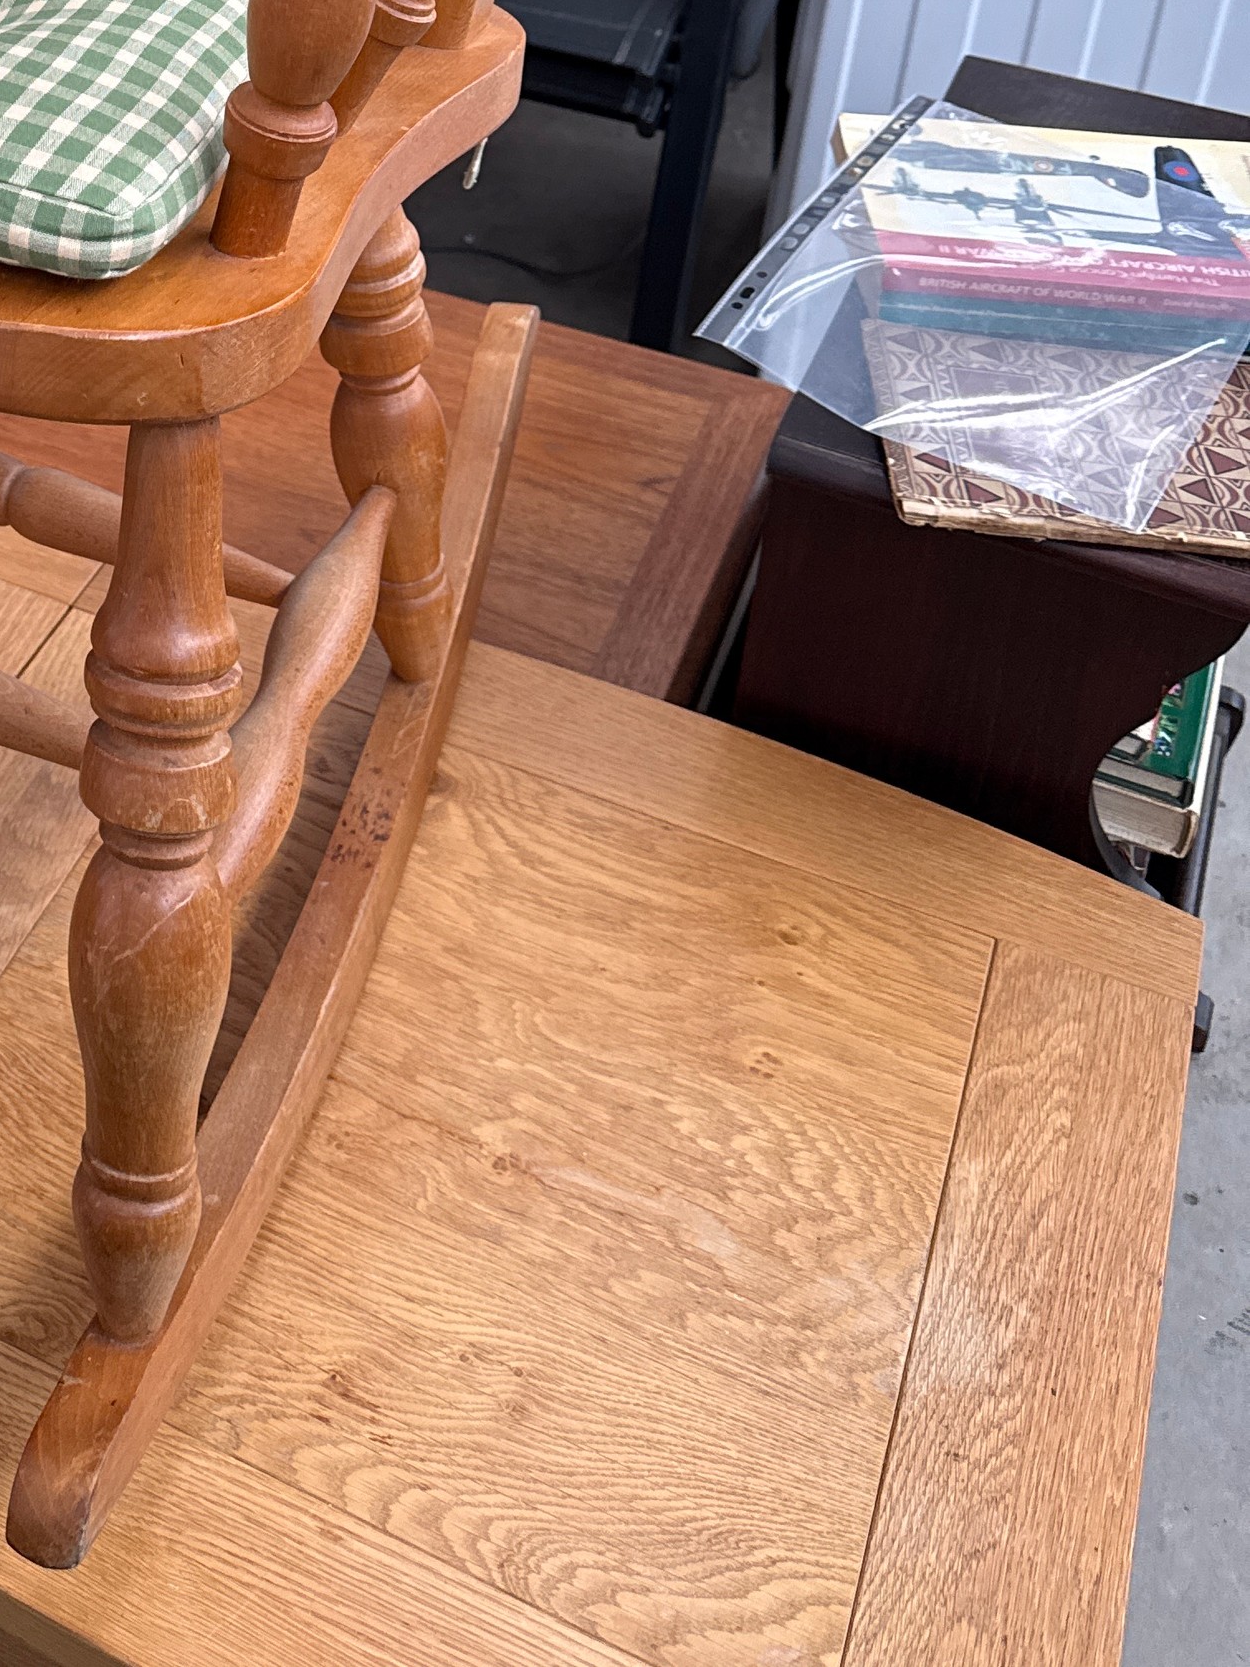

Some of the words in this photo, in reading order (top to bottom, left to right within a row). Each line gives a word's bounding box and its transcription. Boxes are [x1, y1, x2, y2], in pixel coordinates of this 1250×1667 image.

[1109, 258, 1196, 273] AIRCRAFT
[918, 276, 968, 290] BRITISH
[968, 281, 1031, 296] AIRCRAFT
[1032, 286, 1050, 297] OF
[1053, 289, 1102, 301] WORLD
[1102, 293, 1136, 305] WAR
